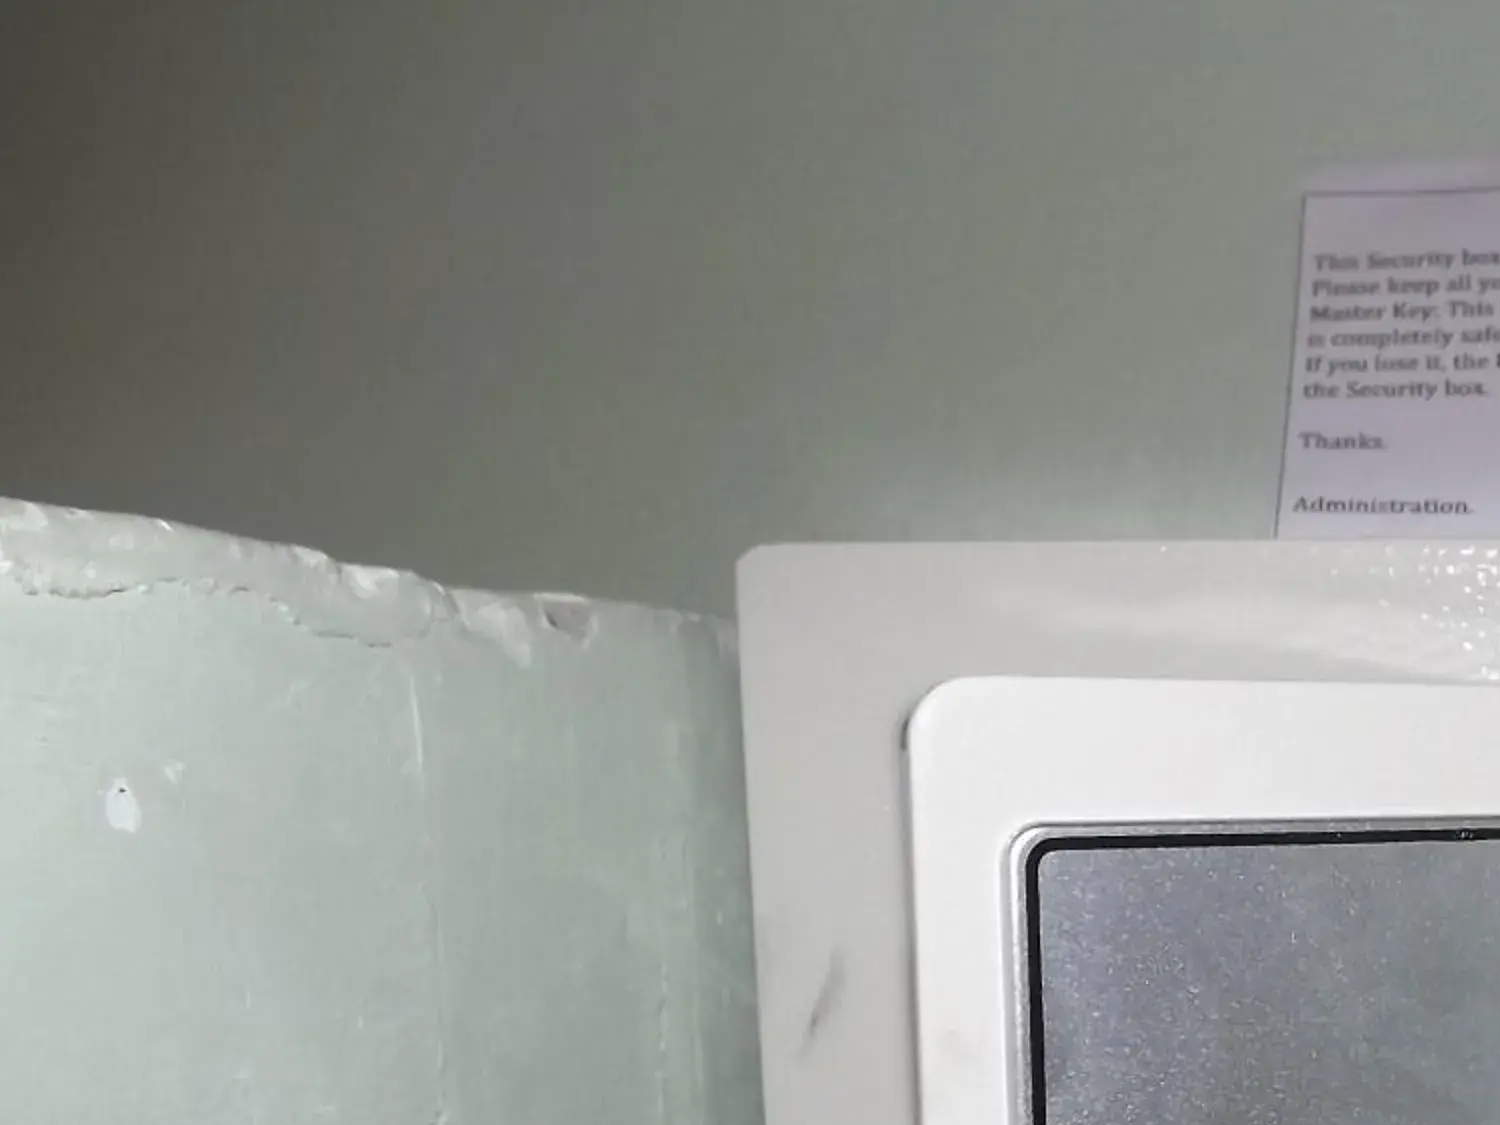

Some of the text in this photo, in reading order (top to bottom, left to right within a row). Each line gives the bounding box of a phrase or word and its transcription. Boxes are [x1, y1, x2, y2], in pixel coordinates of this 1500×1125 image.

[1315, 254, 1359, 271] This
[1367, 252, 1455, 272] Security
[1311, 279, 1379, 297] Please
[1387, 277, 1441, 297] keep
[1445, 275, 1471, 291] all
[1309, 304, 1386, 322] Master
[1448, 301, 1494, 317] This
[1307, 331, 1325, 347] is
[1330, 328, 1454, 349] completely
[1305, 356, 1322, 373] If
[1327, 359, 1368, 376] you
[1374, 355, 1419, 371] lose
[1453, 351, 1490, 369] the
[1303, 380, 1339, 398] the
[1345, 380, 1438, 400] Security
[1292, 496, 1475, 515] Administration.
